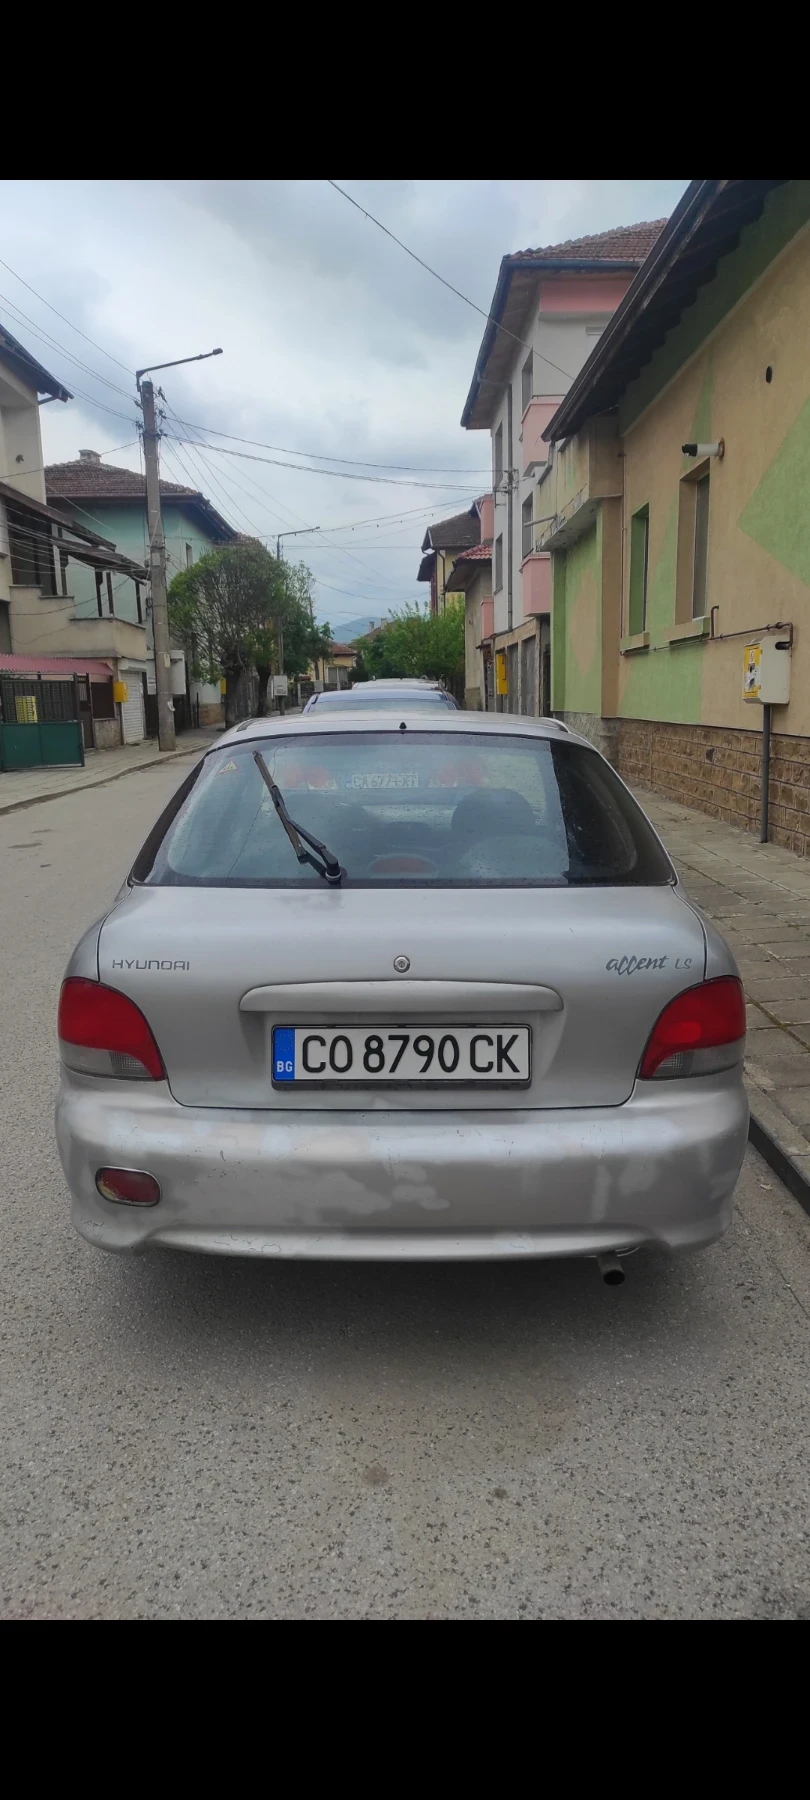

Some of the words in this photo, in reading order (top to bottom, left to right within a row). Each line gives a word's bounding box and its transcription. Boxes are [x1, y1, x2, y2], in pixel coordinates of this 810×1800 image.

[112, 959, 190, 971] HYUNDAI
[674, 957, 693, 970] LS
[276, 1061, 293, 1073] BG
[302, 1035, 354, 1074] CO
[363, 1034, 460, 1074] 8790
[469, 1034, 520, 1073] CK
